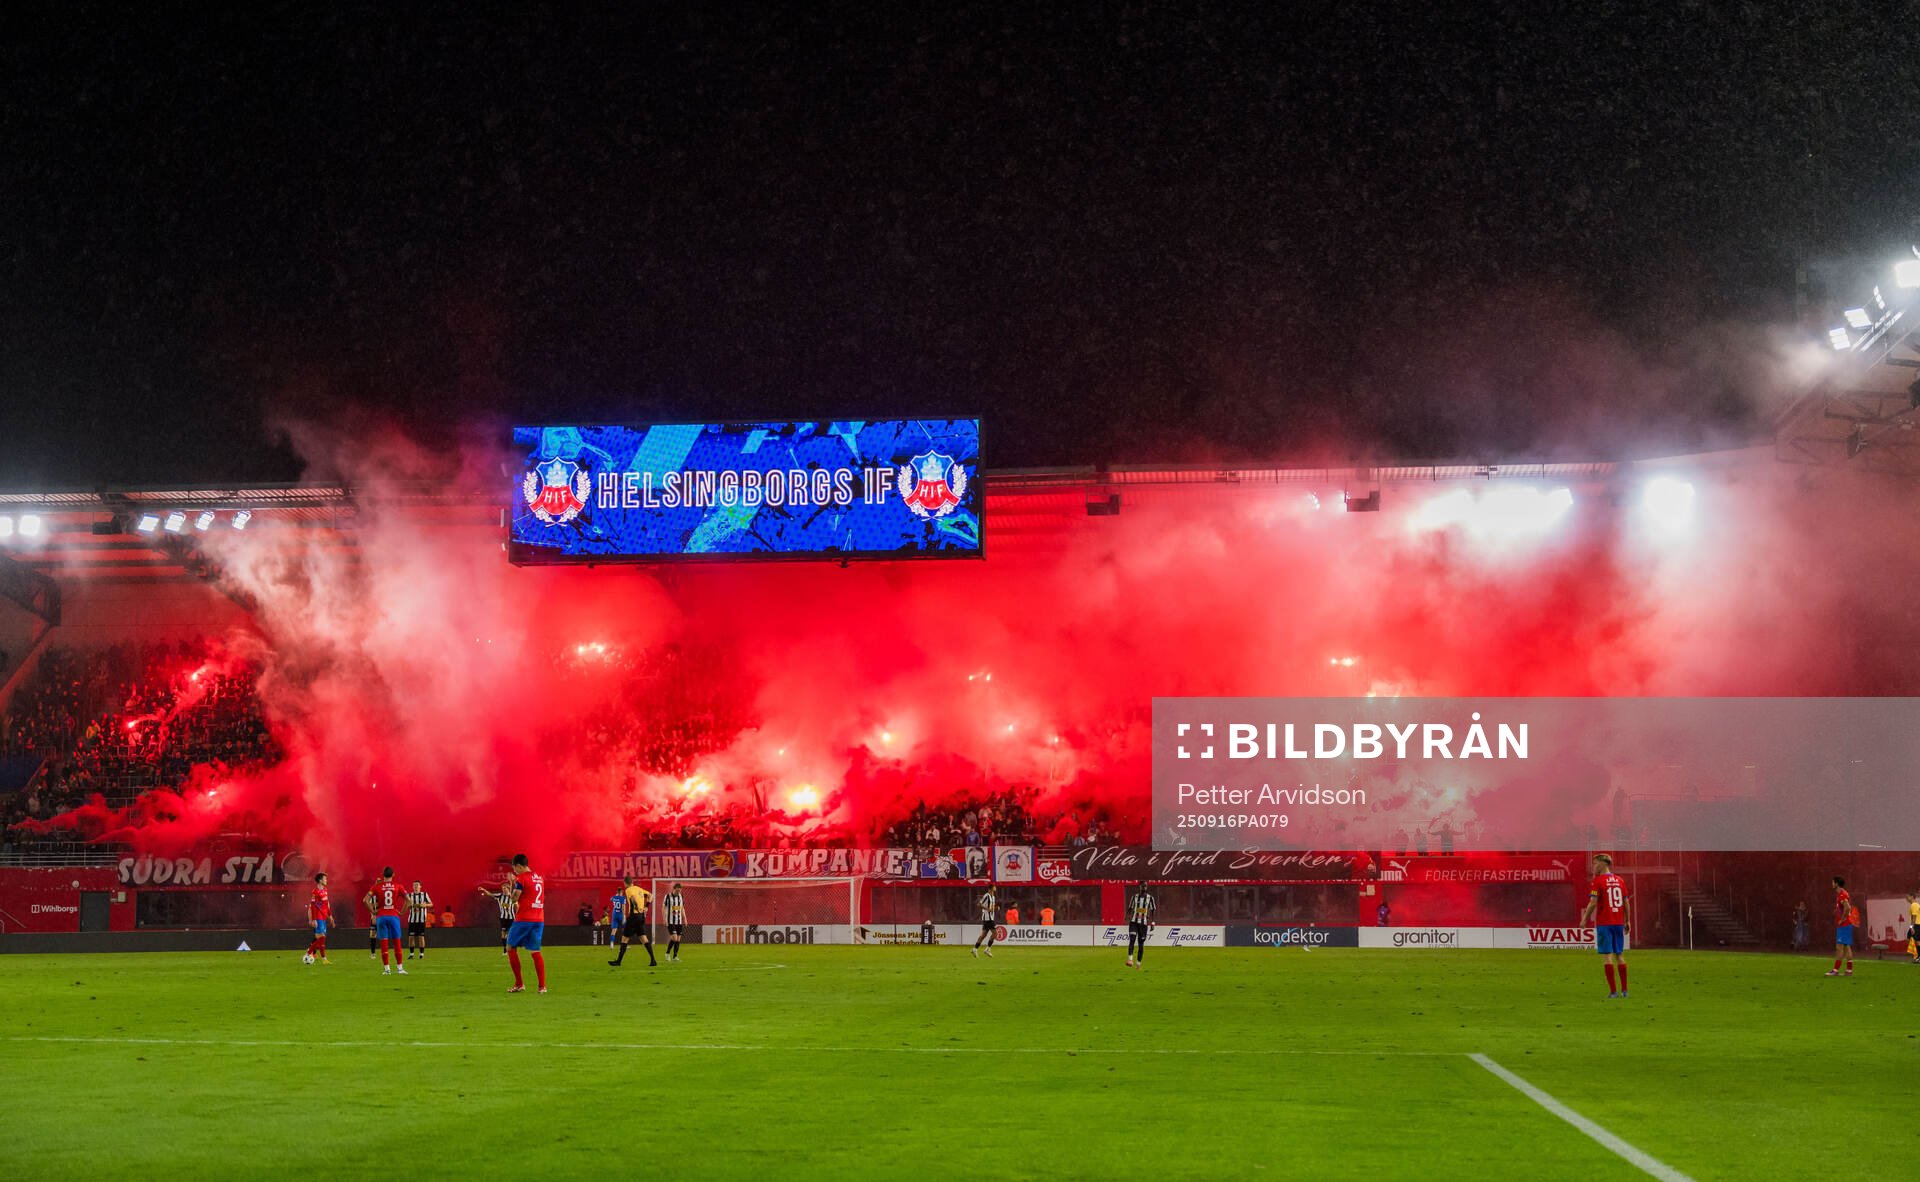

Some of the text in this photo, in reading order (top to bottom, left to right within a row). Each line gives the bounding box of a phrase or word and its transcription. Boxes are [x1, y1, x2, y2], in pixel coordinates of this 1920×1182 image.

[598, 466, 894, 508] HELSINGBORGS IF
[920, 484, 943, 498] HIF
[544, 490, 567, 503] HIF
[222, 851, 274, 884] STÅ
[551, 851, 702, 877] KÅNEPÅGARNA
[1073, 846, 1138, 870] Vila
[1162, 848, 1224, 876] frid
[1038, 861, 1071, 879] Carlsb
[1425, 869, 1480, 880] FOREVER
[384, 890, 393, 906] 8
[535, 883, 542, 904] 2
[1606, 886, 1623, 907] 19
[41, 904, 78, 914] Wihlborgs
[1008, 928, 1062, 939] AllOffice
[1254, 928, 1329, 943] kondektor
[1392, 929, 1455, 947] granitor
[1528, 928, 1595, 942] WANS
